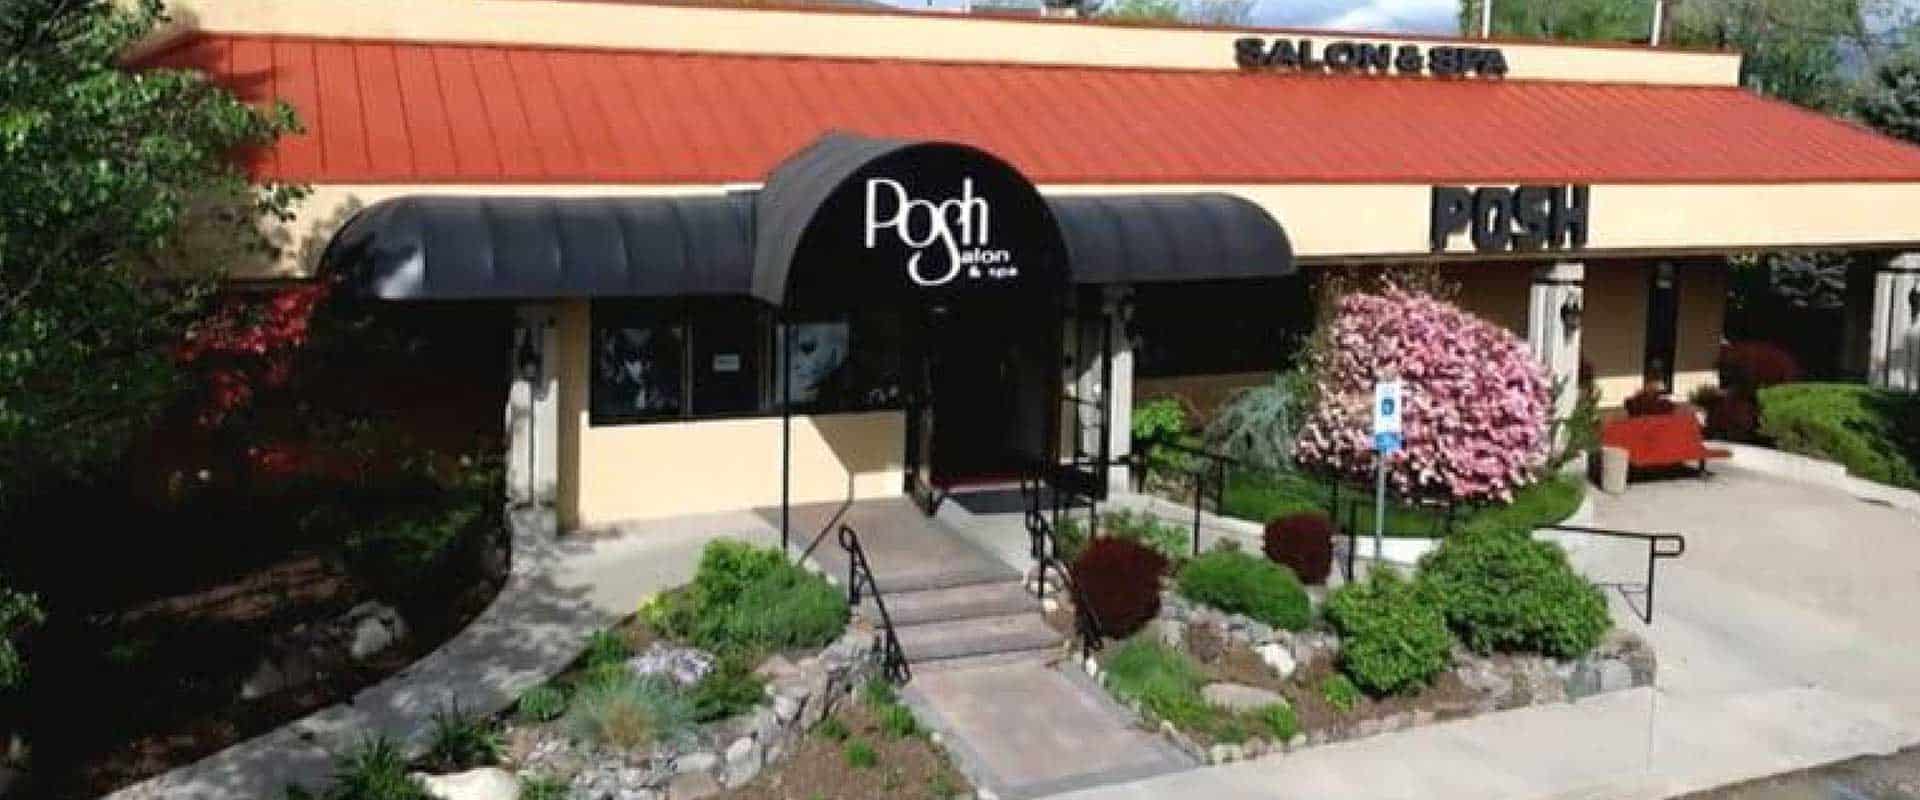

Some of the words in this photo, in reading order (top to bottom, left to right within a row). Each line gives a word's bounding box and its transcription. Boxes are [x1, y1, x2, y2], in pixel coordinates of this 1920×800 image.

[1234, 38, 1389, 70] SALON
[1395, 44, 1424, 73] &
[1429, 46, 1508, 76] SPA
[866, 178, 988, 286] Posh
[1431, 185, 1588, 251] POSH
[988, 266, 1019, 279] spa
